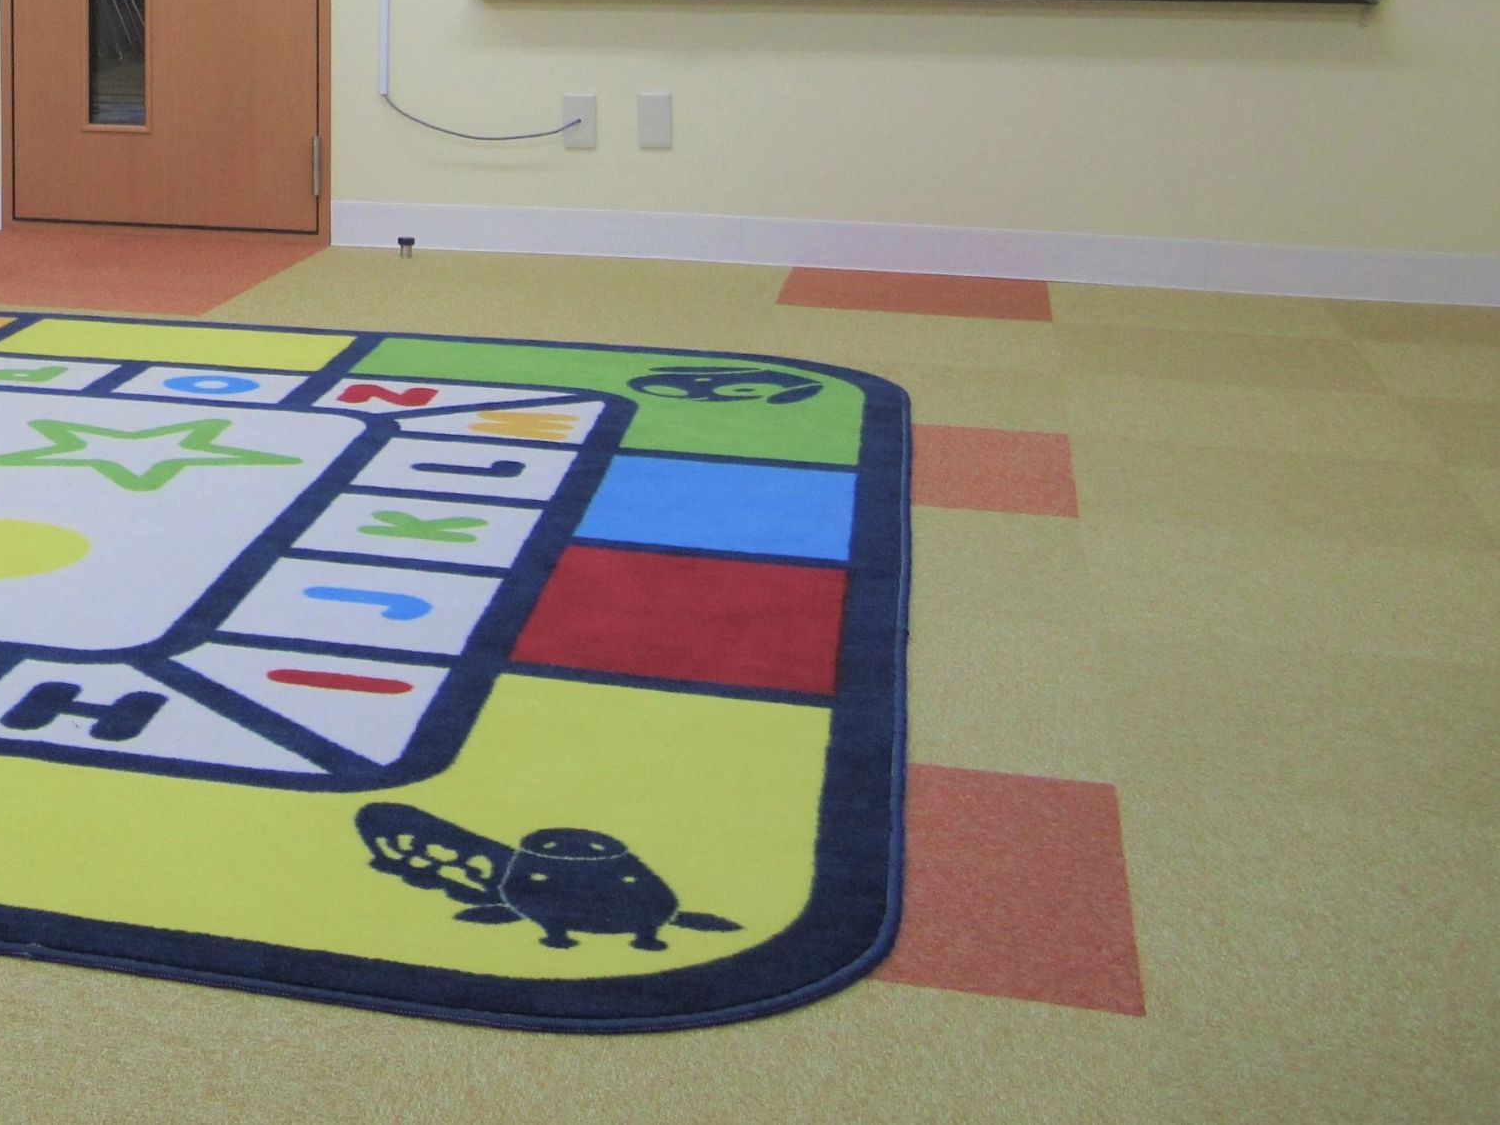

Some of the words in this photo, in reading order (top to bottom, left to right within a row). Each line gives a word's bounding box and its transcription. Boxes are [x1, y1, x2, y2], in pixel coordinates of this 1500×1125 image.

[164, 375, 260, 395] O
[336, 384, 439, 407] N
[410, 460, 526, 478] L
[360, 511, 487, 543] K
[303, 586, 433, 621] J
[266, 669, 414, 695] I
[0, 680, 170, 742] H
